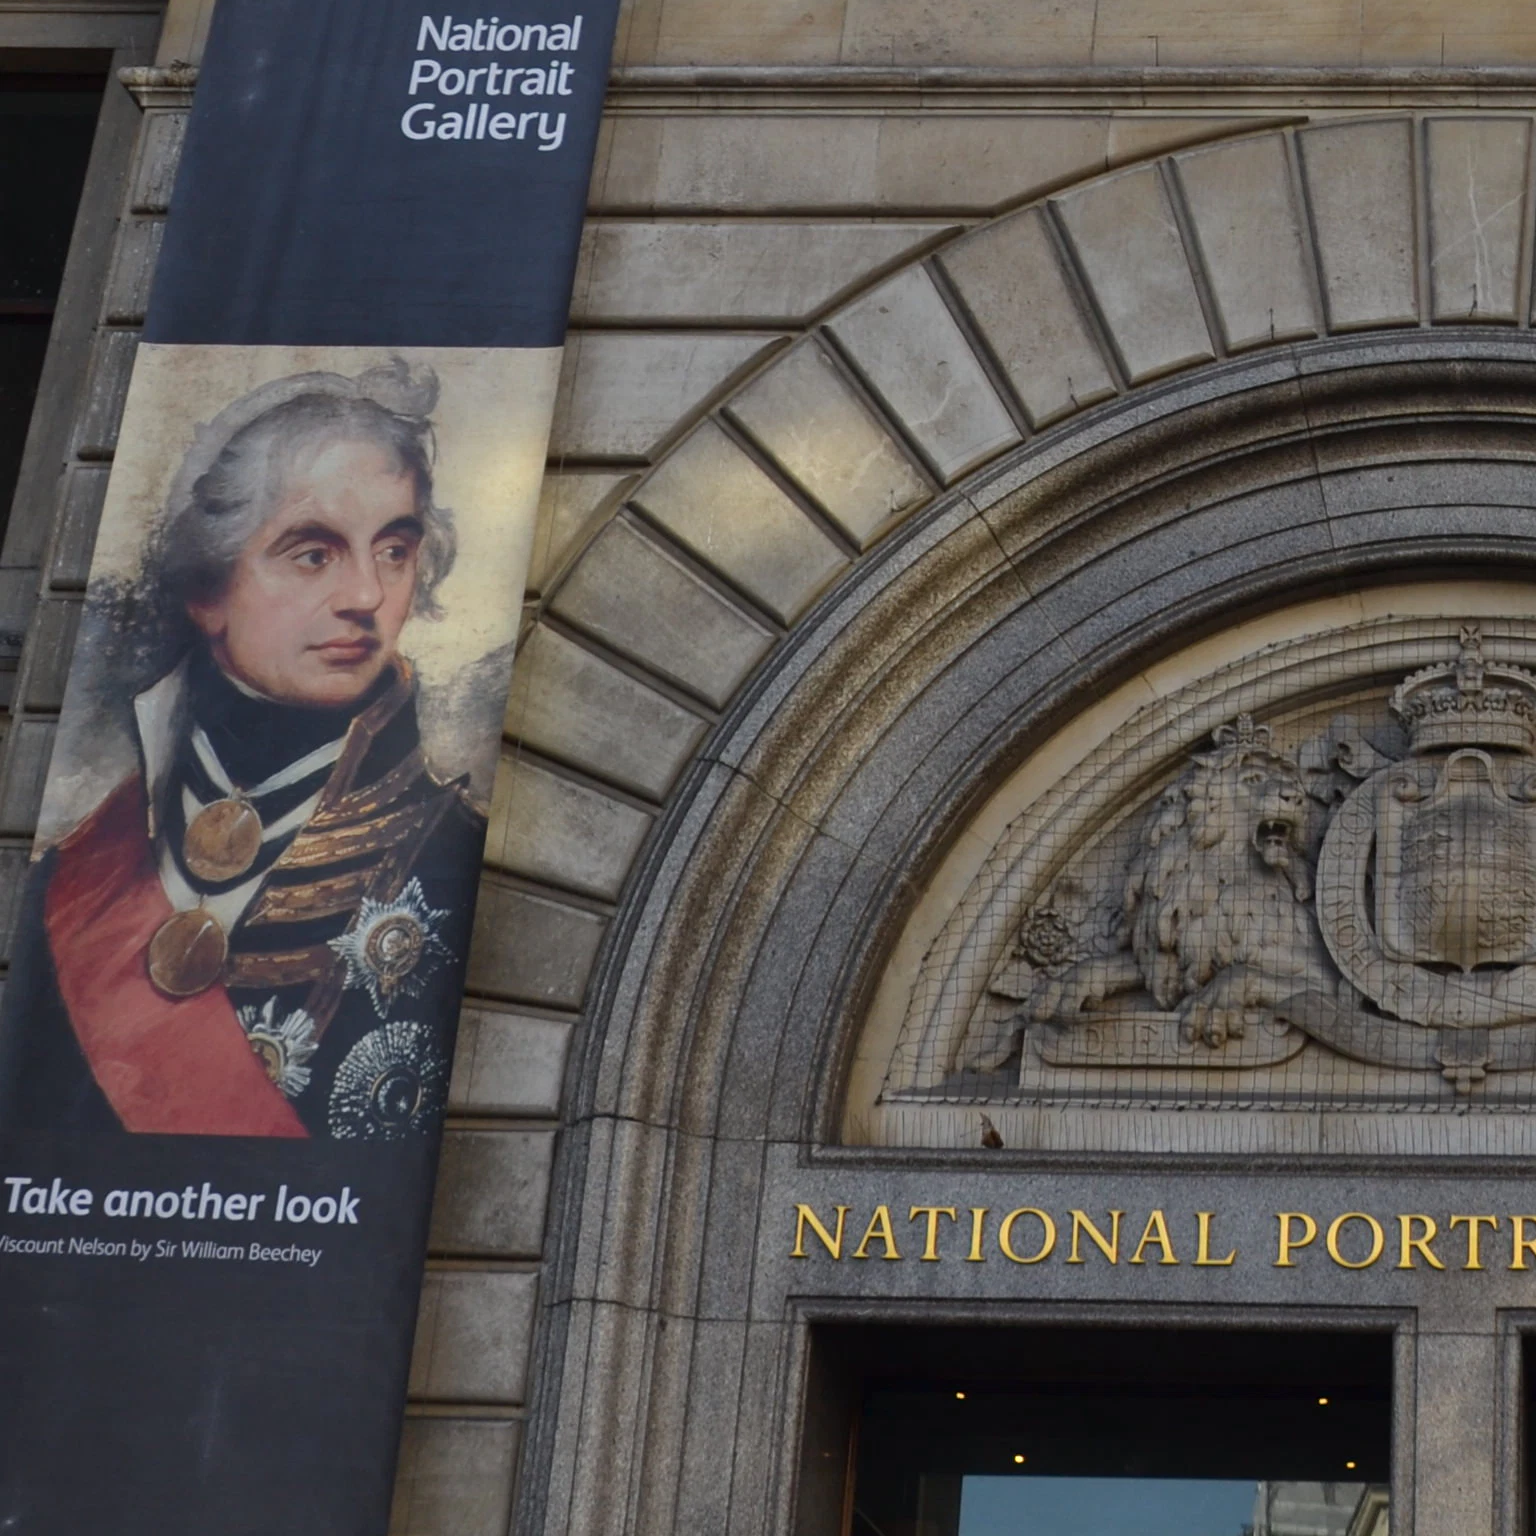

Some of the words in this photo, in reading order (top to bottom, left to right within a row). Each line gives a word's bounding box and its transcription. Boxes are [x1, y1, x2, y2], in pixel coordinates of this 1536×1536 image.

[415, 15, 583, 51] National
[408, 59, 575, 95] Portrait
[400, 102, 567, 151] Gallery
[3, 1176, 94, 1216] Take
[103, 1181, 267, 1221] another
[274, 1184, 361, 1224] look
[67, 1236, 127, 1256] Nelson
[130, 1239, 152, 1262] by
[155, 1238, 177, 1258] Sir
[181, 1240, 245, 1260] William
[248, 1242, 323, 1268] Beechey
[792, 1204, 1236, 1266] NATIONAL
